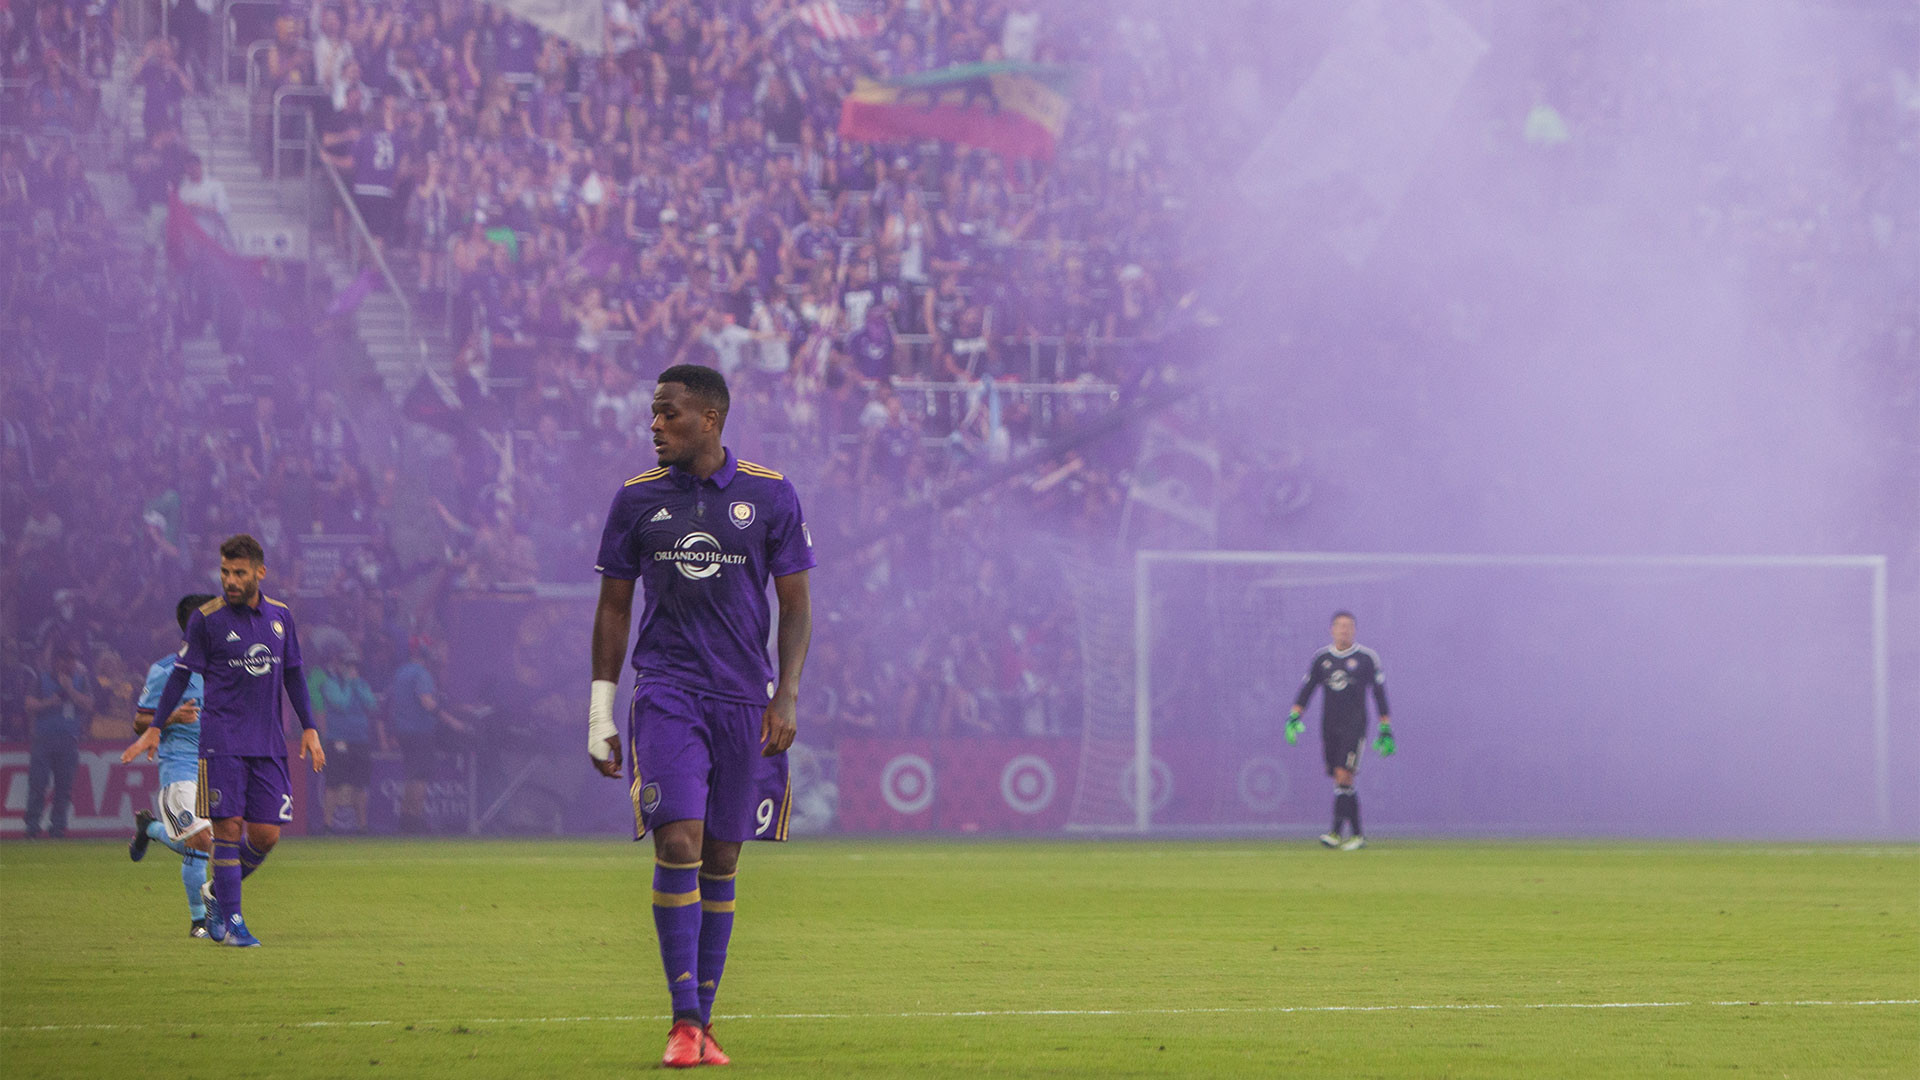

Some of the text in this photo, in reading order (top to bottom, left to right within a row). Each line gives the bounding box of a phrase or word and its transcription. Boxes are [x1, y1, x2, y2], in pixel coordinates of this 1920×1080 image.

[654, 551, 747, 565] ORLANDO HEALTH
[755, 798, 774, 836] 9
